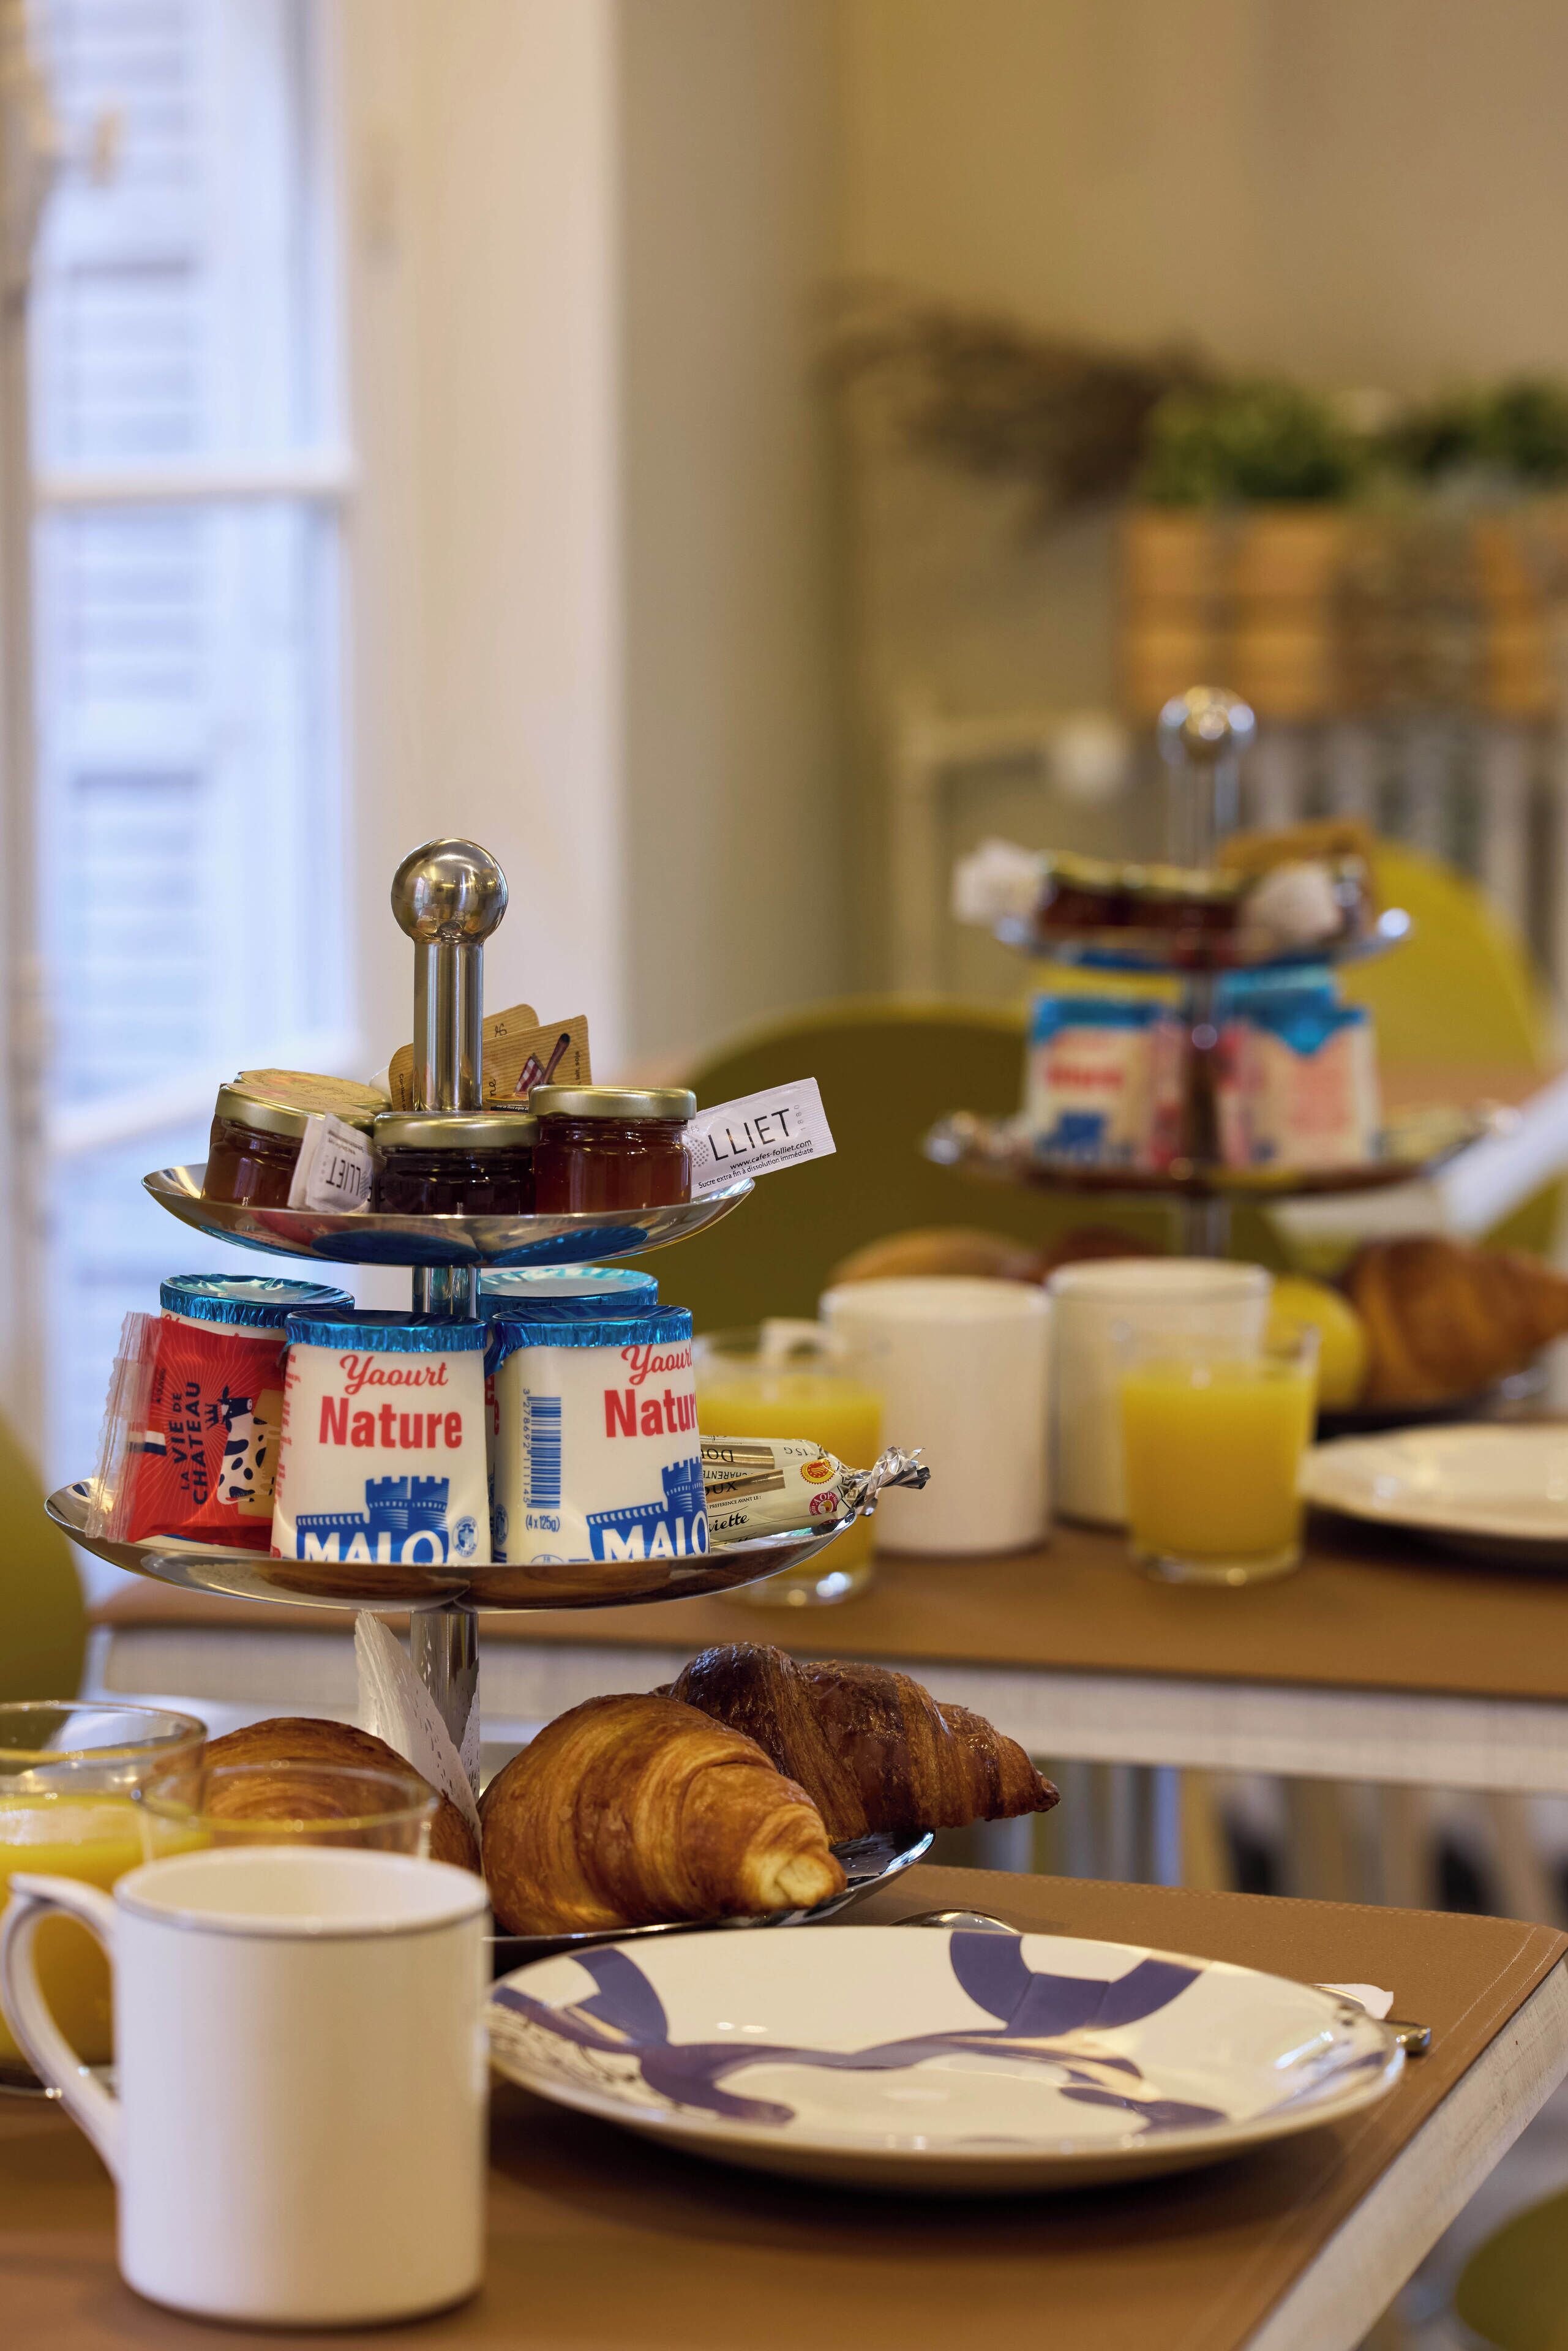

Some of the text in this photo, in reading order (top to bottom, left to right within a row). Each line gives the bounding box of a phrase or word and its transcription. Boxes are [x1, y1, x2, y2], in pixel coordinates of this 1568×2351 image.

[698, 1178, 716, 1188] Sucre
[716, 1174, 732, 1182] extra
[747, 1158, 780, 1172] dissolution
[781, 1147, 814, 1162] immédiate
[730, 1139, 812, 1169] www.cafes-folliet.com
[339, 1354, 449, 1395] Yaourt
[319, 1395, 463, 1450] Nature
[604, 1389, 699, 1438] Natur
[168, 1393, 190, 1490] LA VIE DE
[186, 1382, 208, 1505] CHATEAU
[709, 1499, 738, 1509] PREFERENCE
[814, 1491, 833, 1506] AOP
